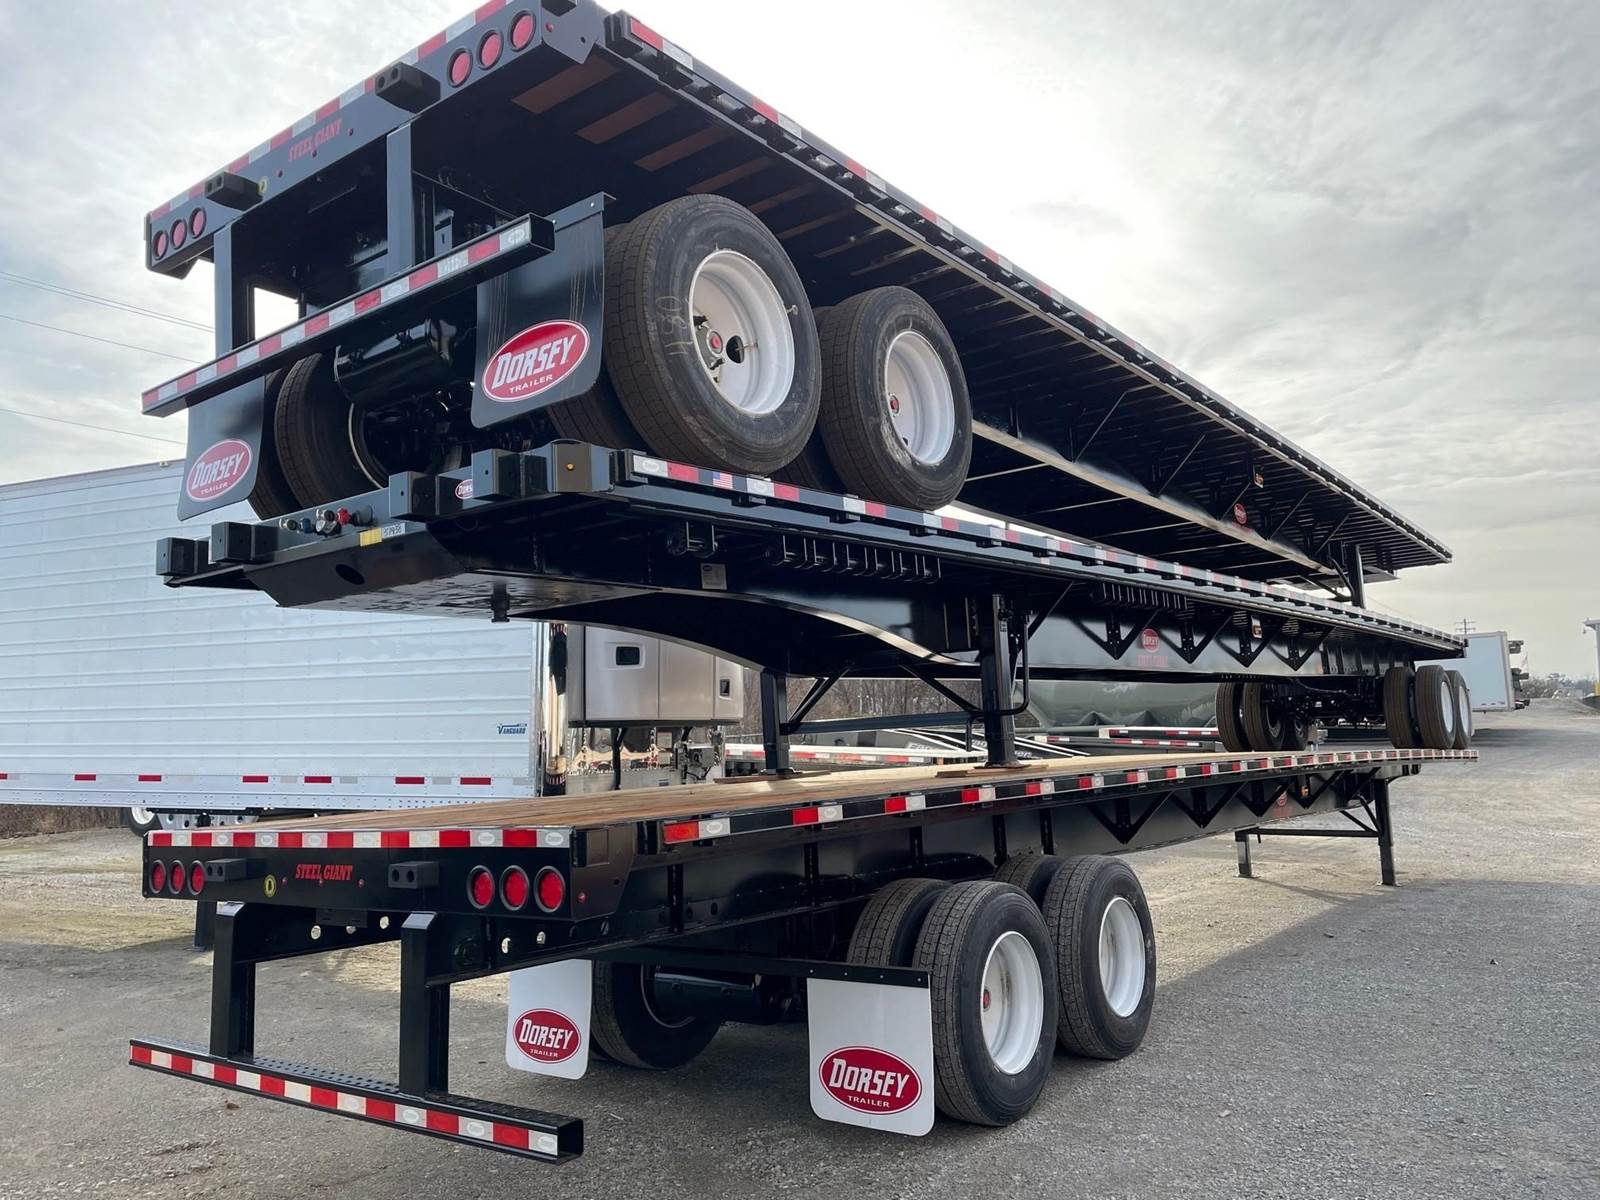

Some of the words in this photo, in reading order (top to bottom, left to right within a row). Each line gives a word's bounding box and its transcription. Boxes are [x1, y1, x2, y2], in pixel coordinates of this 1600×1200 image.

[288, 137, 313, 162] STEEL
[314, 119, 342, 148] GIANT
[491, 334, 577, 390] DORSEY
[509, 374, 554, 394] TRAILER
[191, 451, 245, 491] DORSEY
[201, 481, 228, 495] TRAILER
[497, 723, 527, 735] VANGUARD
[295, 863, 322, 880] STEEL
[323, 864, 354, 881] GIANT
[518, 1018, 574, 1050] DORSEY
[530, 1048, 559, 1058] TRAILER
[828, 1058, 910, 1099] DORSEY
[847, 1095, 890, 1109] TRAILER
